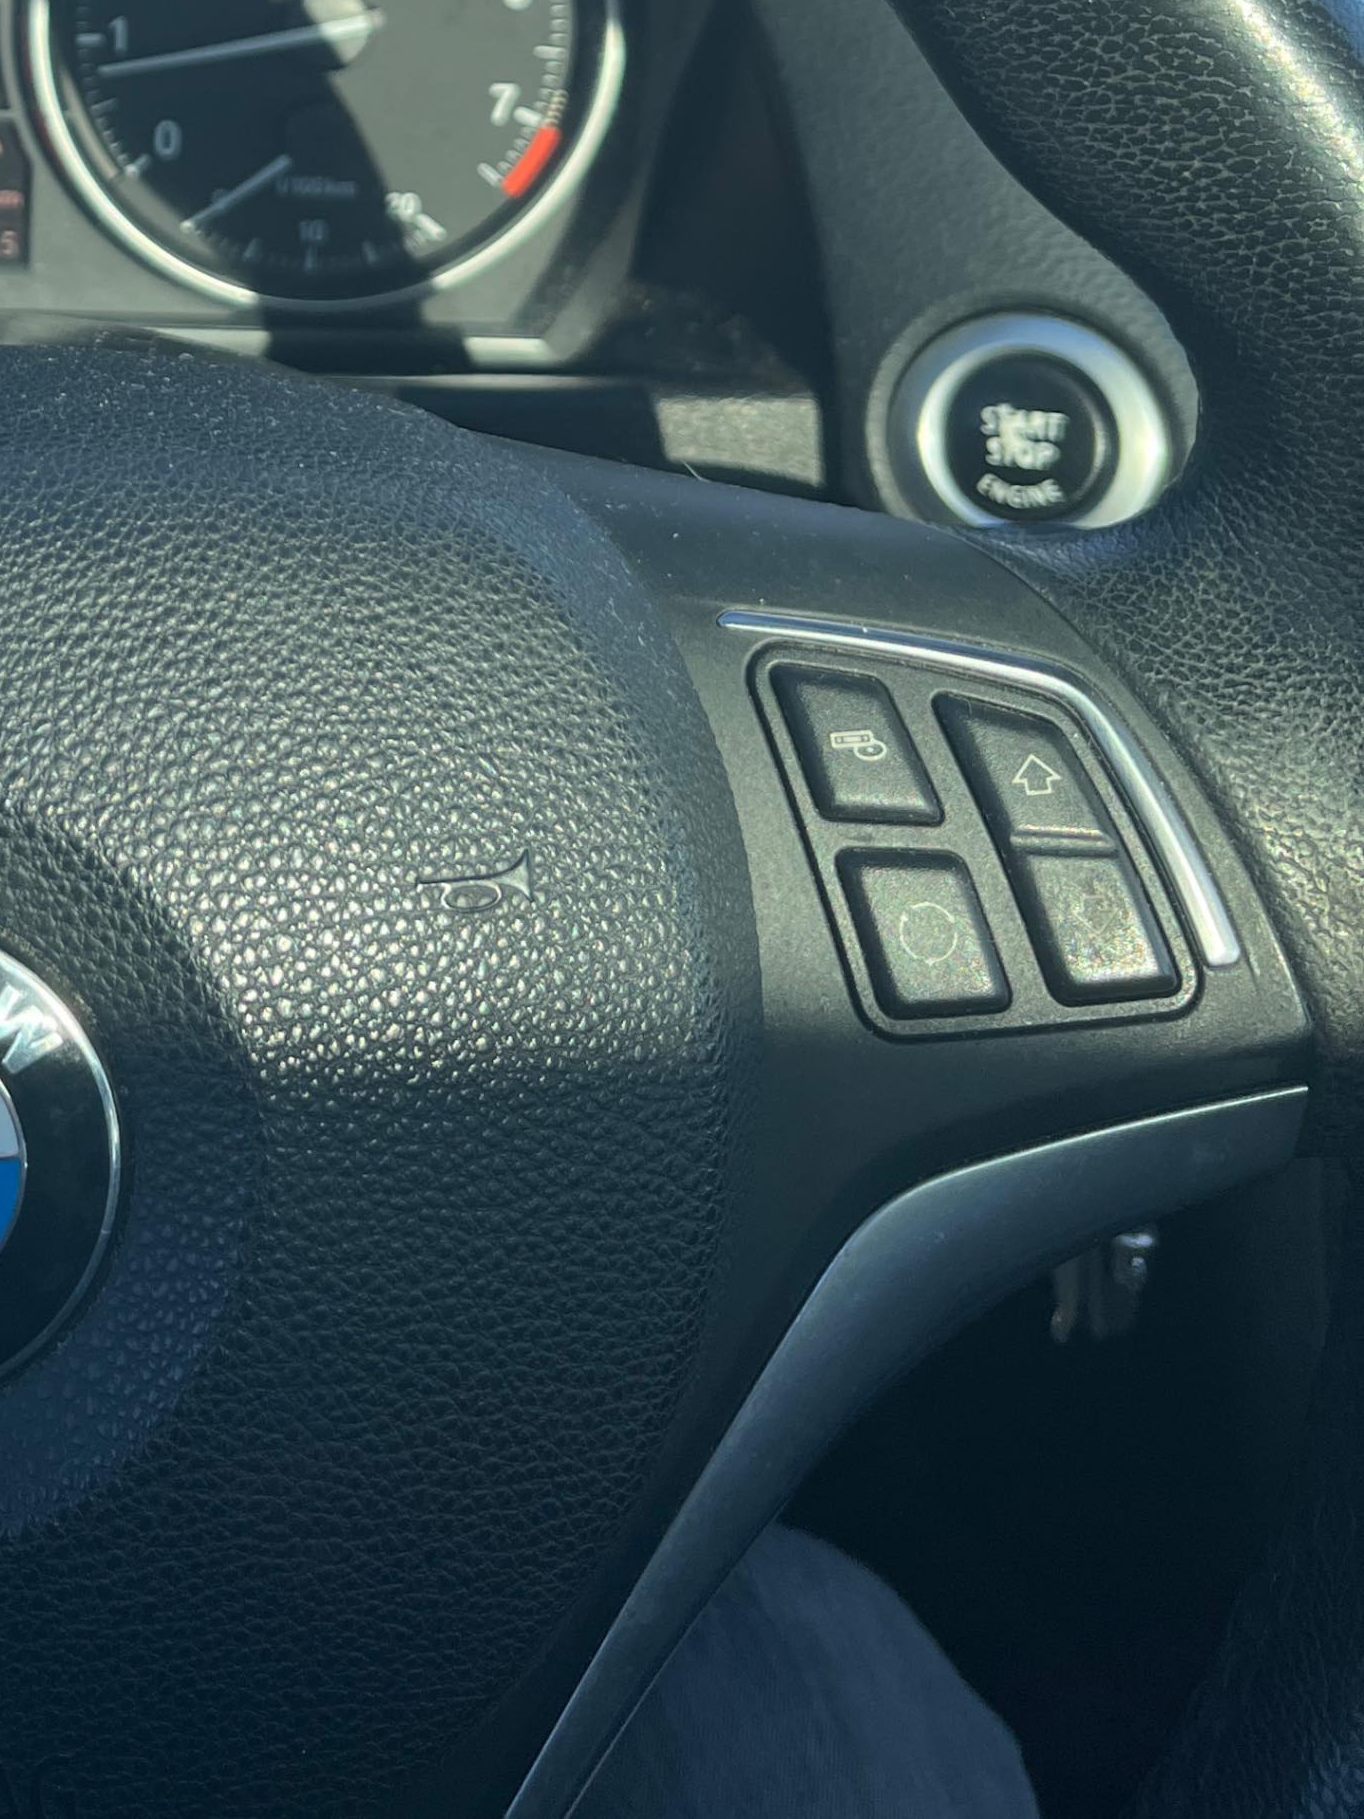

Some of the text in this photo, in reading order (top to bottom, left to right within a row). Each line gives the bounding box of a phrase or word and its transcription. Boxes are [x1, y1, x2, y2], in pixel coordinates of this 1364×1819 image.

[108, 15, 128, 54] 1
[489, 83, 521, 126] 7
[153, 119, 182, 160] 0
[385, 191, 423, 222] 20
[298, 219, 329, 242] 10
